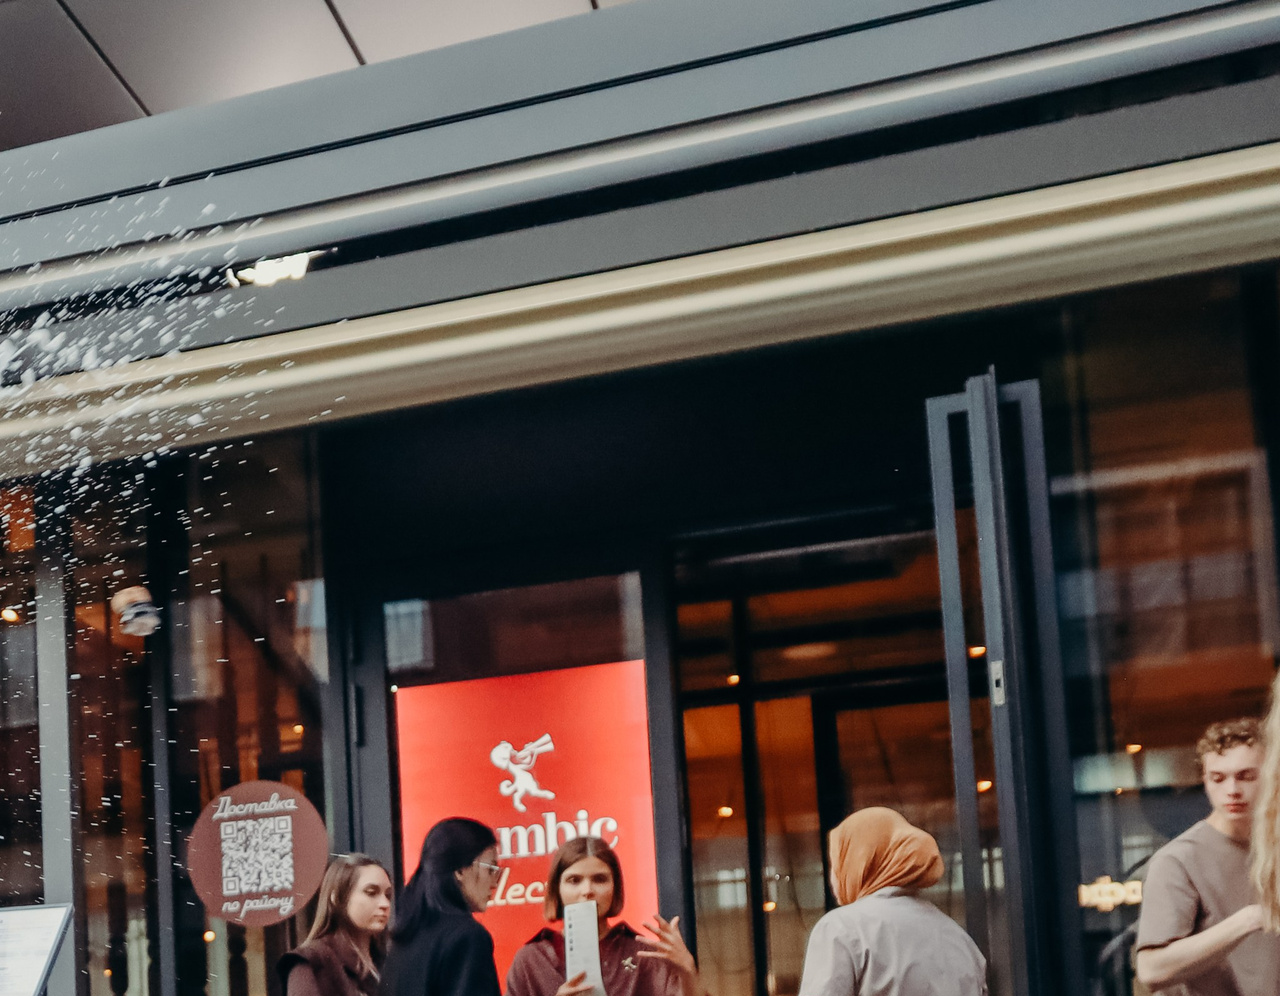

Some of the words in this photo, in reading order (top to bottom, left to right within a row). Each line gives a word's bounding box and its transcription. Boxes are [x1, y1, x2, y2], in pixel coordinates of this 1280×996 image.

[212, 793, 298, 820] Доставка
[496, 810, 619, 859] mbic
[222, 900, 240, 913] по
[240, 895, 294, 918] району
